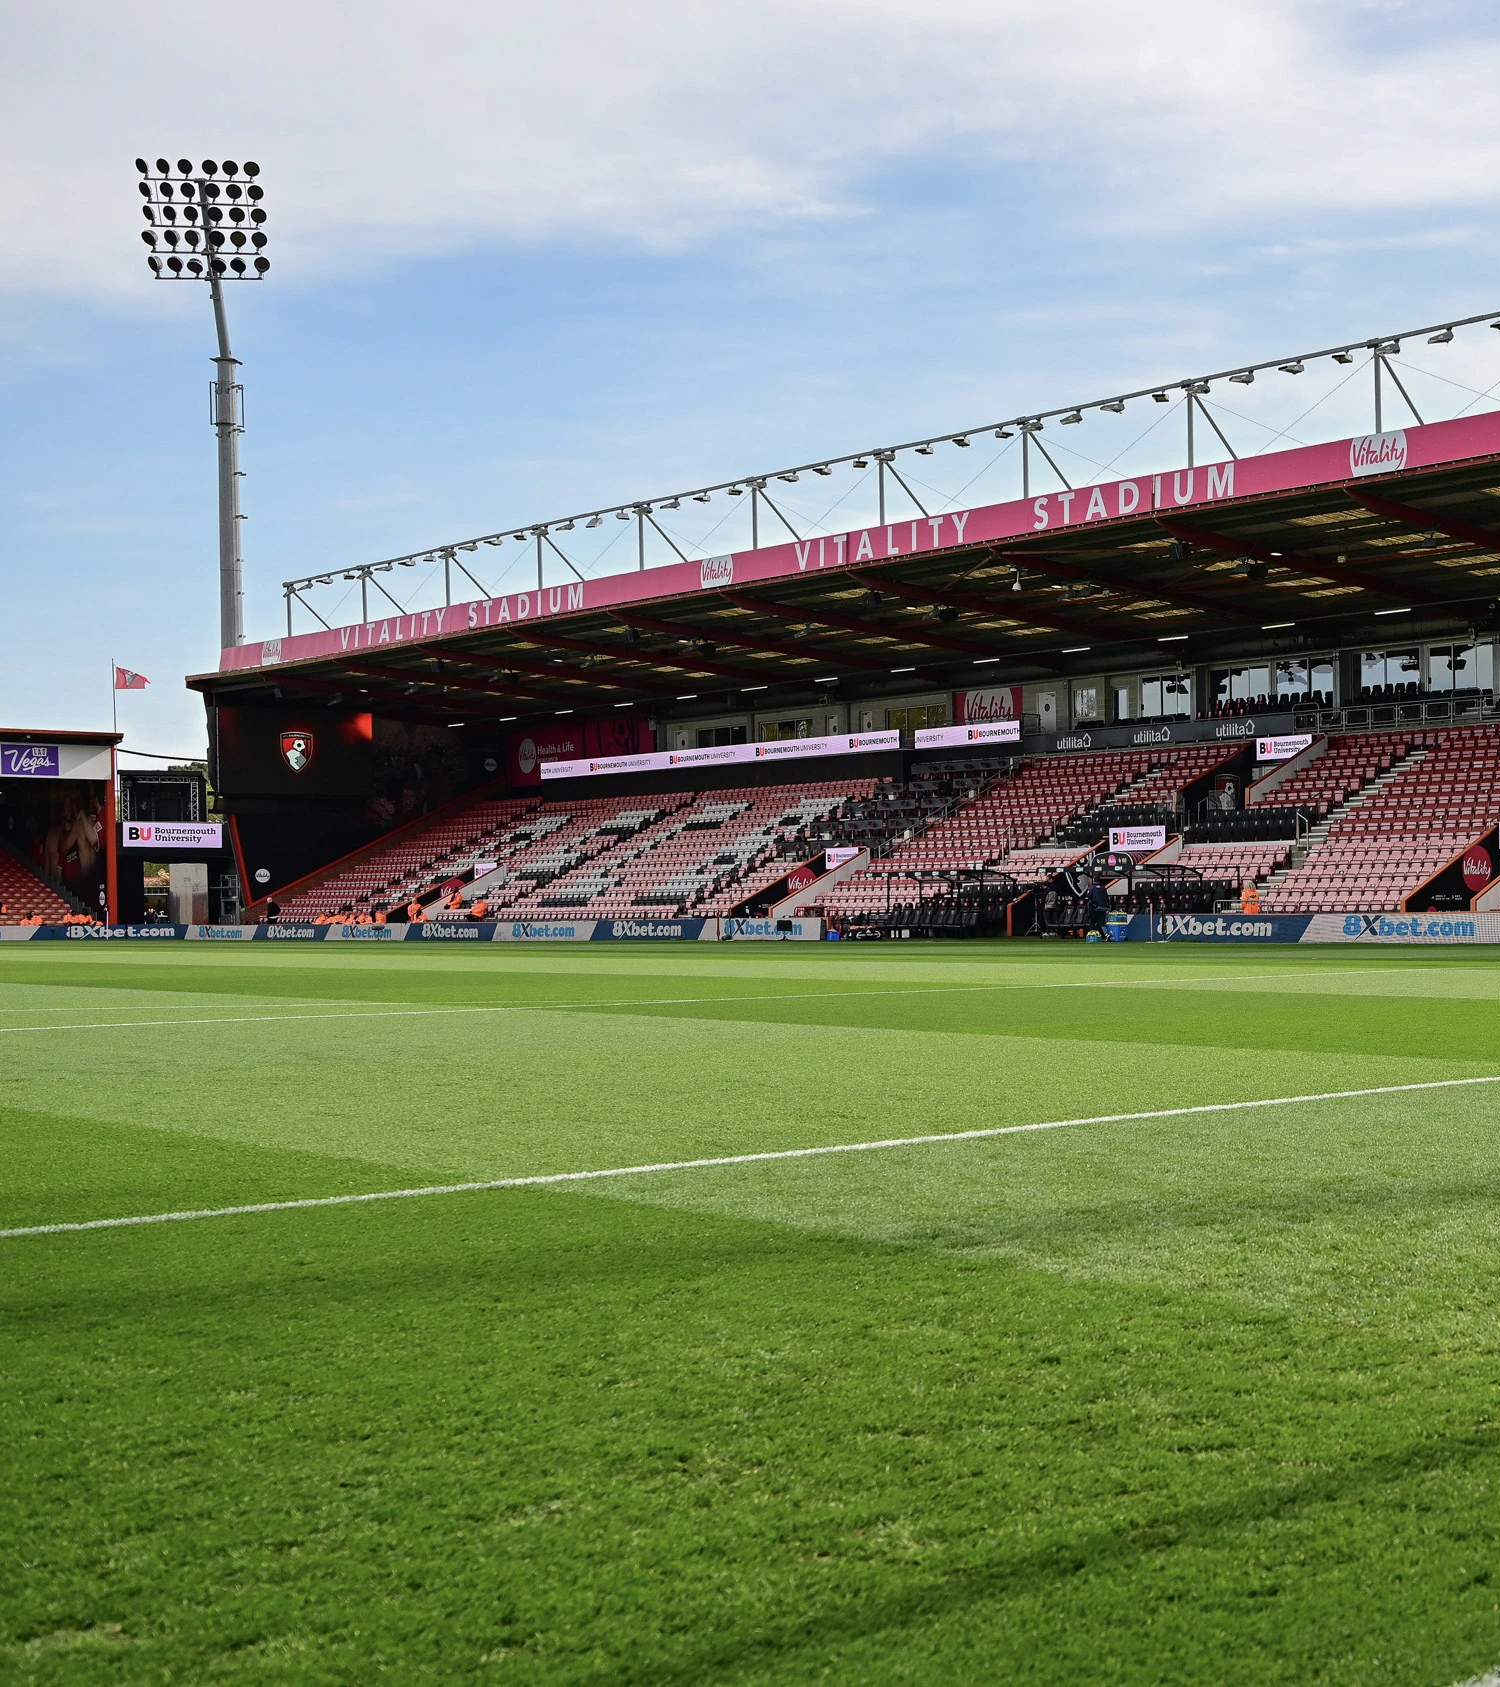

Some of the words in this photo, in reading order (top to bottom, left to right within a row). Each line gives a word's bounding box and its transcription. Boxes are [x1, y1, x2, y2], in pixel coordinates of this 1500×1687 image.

[1351, 433, 1405, 470] Vitality
[794, 511, 970, 571] VITALITY
[1032, 462, 1235, 531] STADIUM
[700, 558, 734, 587] Vitality
[339, 607, 450, 650] VITALITY
[467, 583, 585, 629] STADIUM
[966, 691, 1013, 722] Vitality
[979, 728, 1020, 738] BOURNEMOUTH
[1133, 731, 1162, 743] utilita
[1215, 724, 1246, 737] utilita
[537, 743, 556, 755] Health
[562, 741, 574, 752] Life
[765, 745, 800, 755] BOURNEMOUTH
[800, 742, 828, 752] UNIVERSITY
[859, 737, 898, 747] BOURNEMOUTH
[1056, 738, 1083, 749] utilita
[1273, 738, 1309, 748] Bournemouth
[33, 747, 47, 757] LAS
[1273, 745, 1301, 754] University
[4, 748, 56, 774] Vegas
[678, 753, 710, 763] BOURNEMOUTH
[710, 751, 736, 760] UNIVERSITY
[552, 766, 574, 774] UNIVERSITY
[598, 761, 627, 770] BOURNEMOUTH
[628, 759, 651, 767] UNIVERSITY
[128, 827, 152, 841] BU
[155, 827, 217, 835] Bournemouth
[1126, 829, 1163, 839] Bournemouth
[155, 834, 202, 843] University
[1126, 836, 1154, 846] University
[1463, 857, 1491, 881] Vitality
[66, 925, 175, 940] 8Xbet.com
[198, 925, 243, 939] 8Xbet.com
[266, 924, 315, 940] 8Xbet.com
[422, 923, 478, 941] 8Xbet.com
[511, 922, 575, 941] 8Xbet.com
[612, 921, 682, 940] 8Xbet.com
[1156, 915, 1273, 940] 8Xbet.com
[1342, 914, 1475, 941] 8Xbet.com
